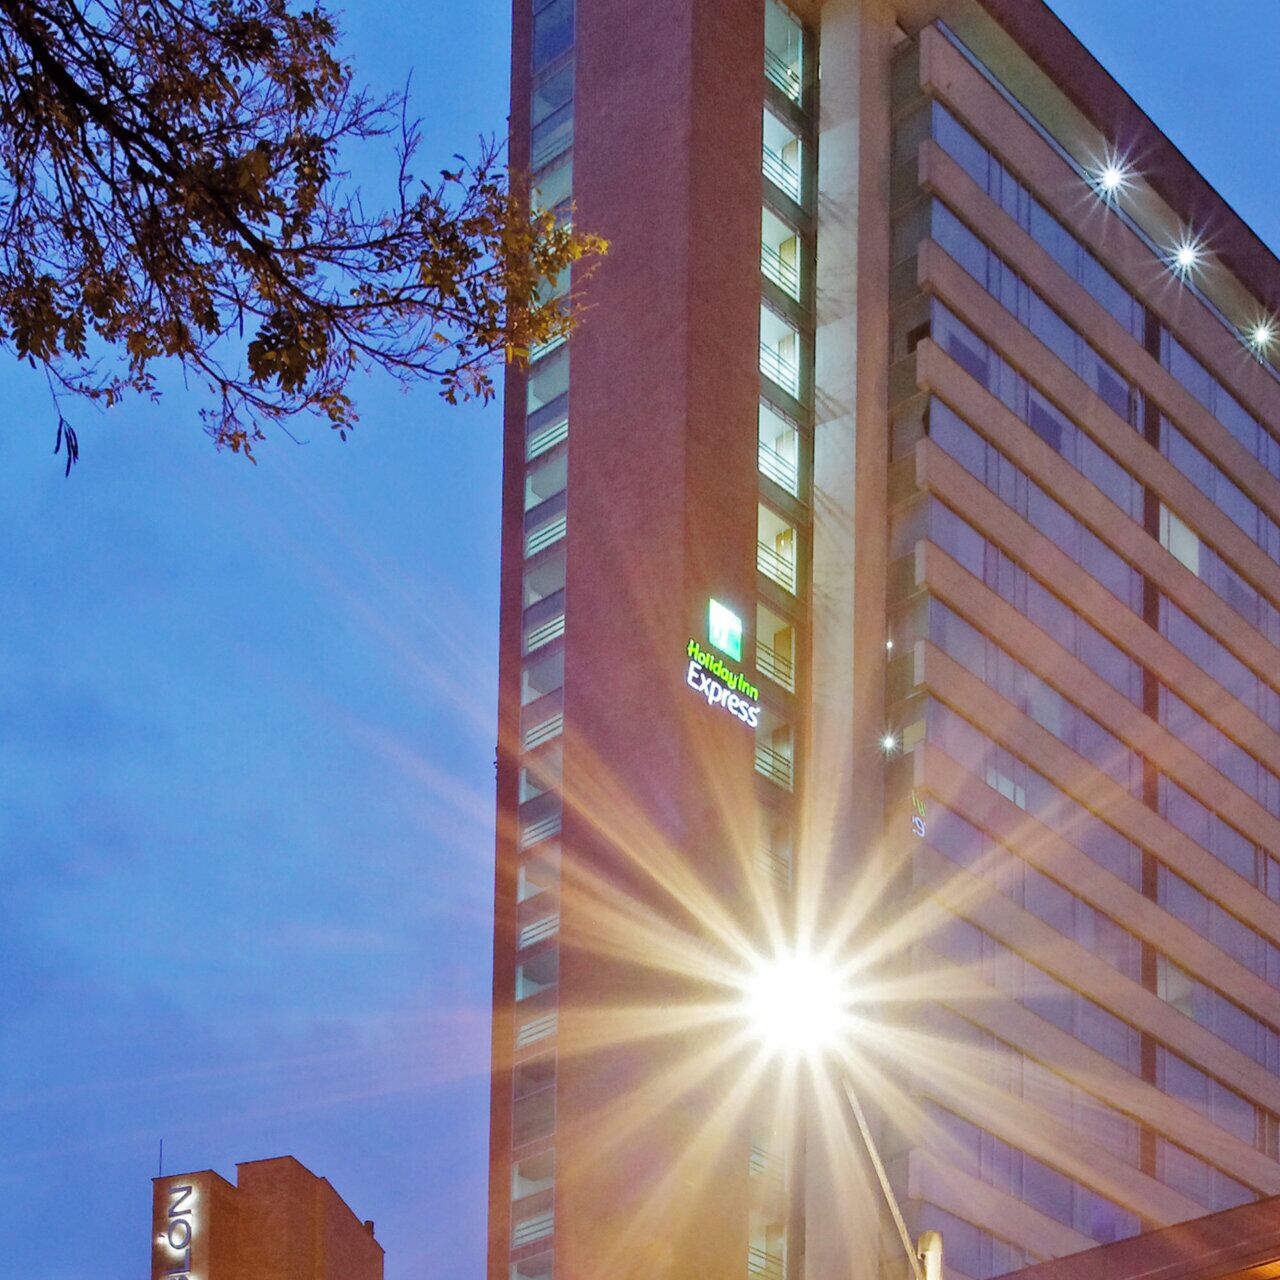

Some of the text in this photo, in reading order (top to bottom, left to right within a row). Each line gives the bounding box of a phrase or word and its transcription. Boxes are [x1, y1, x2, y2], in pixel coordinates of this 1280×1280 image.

[687, 639, 759, 701] Holiday Inn
[687, 660, 759, 728] Express
